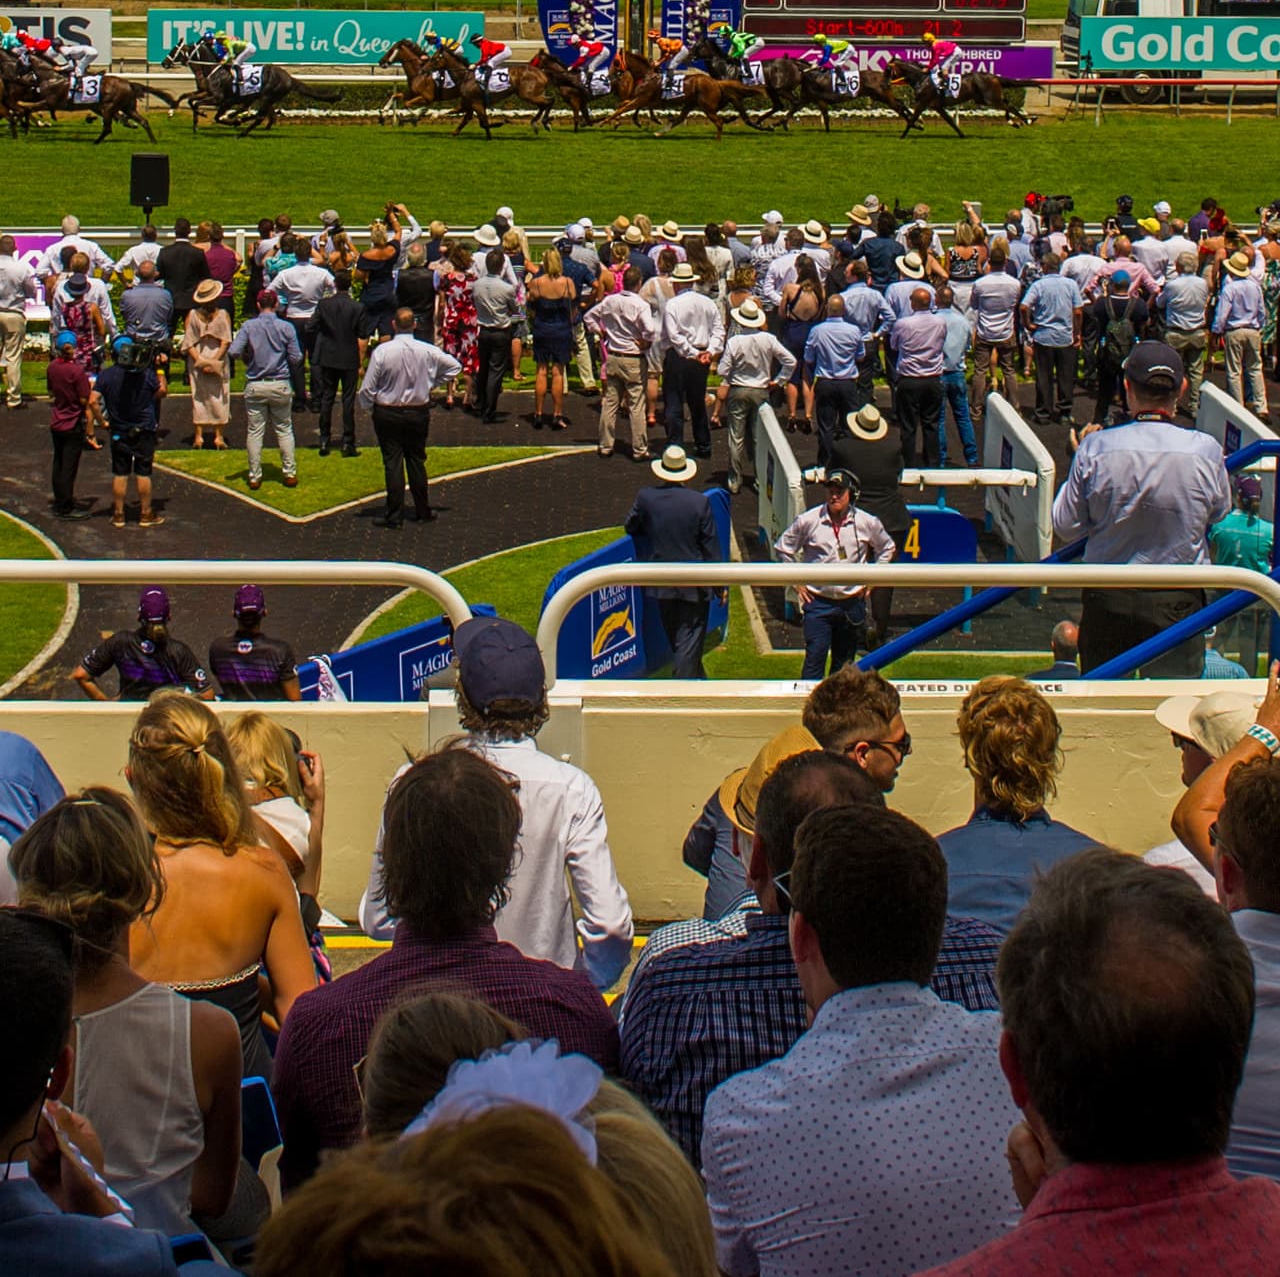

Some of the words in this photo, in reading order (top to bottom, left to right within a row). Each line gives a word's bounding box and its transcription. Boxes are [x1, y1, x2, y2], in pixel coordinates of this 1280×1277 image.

[310, 37, 328, 51] in
[906, 48, 1002, 61] THOHBRED
[1101, 24, 1214, 63] Gold
[86, 79, 99, 96] 3
[904, 518, 920, 559] 4
[599, 592, 627, 614] MILLIONS
[412, 649, 454, 680] MAGIC
[592, 658, 611, 678] Gold
[613, 645, 637, 666] Coast
[895, 684, 948, 692] EATED
[1040, 684, 1063, 692] ACE
